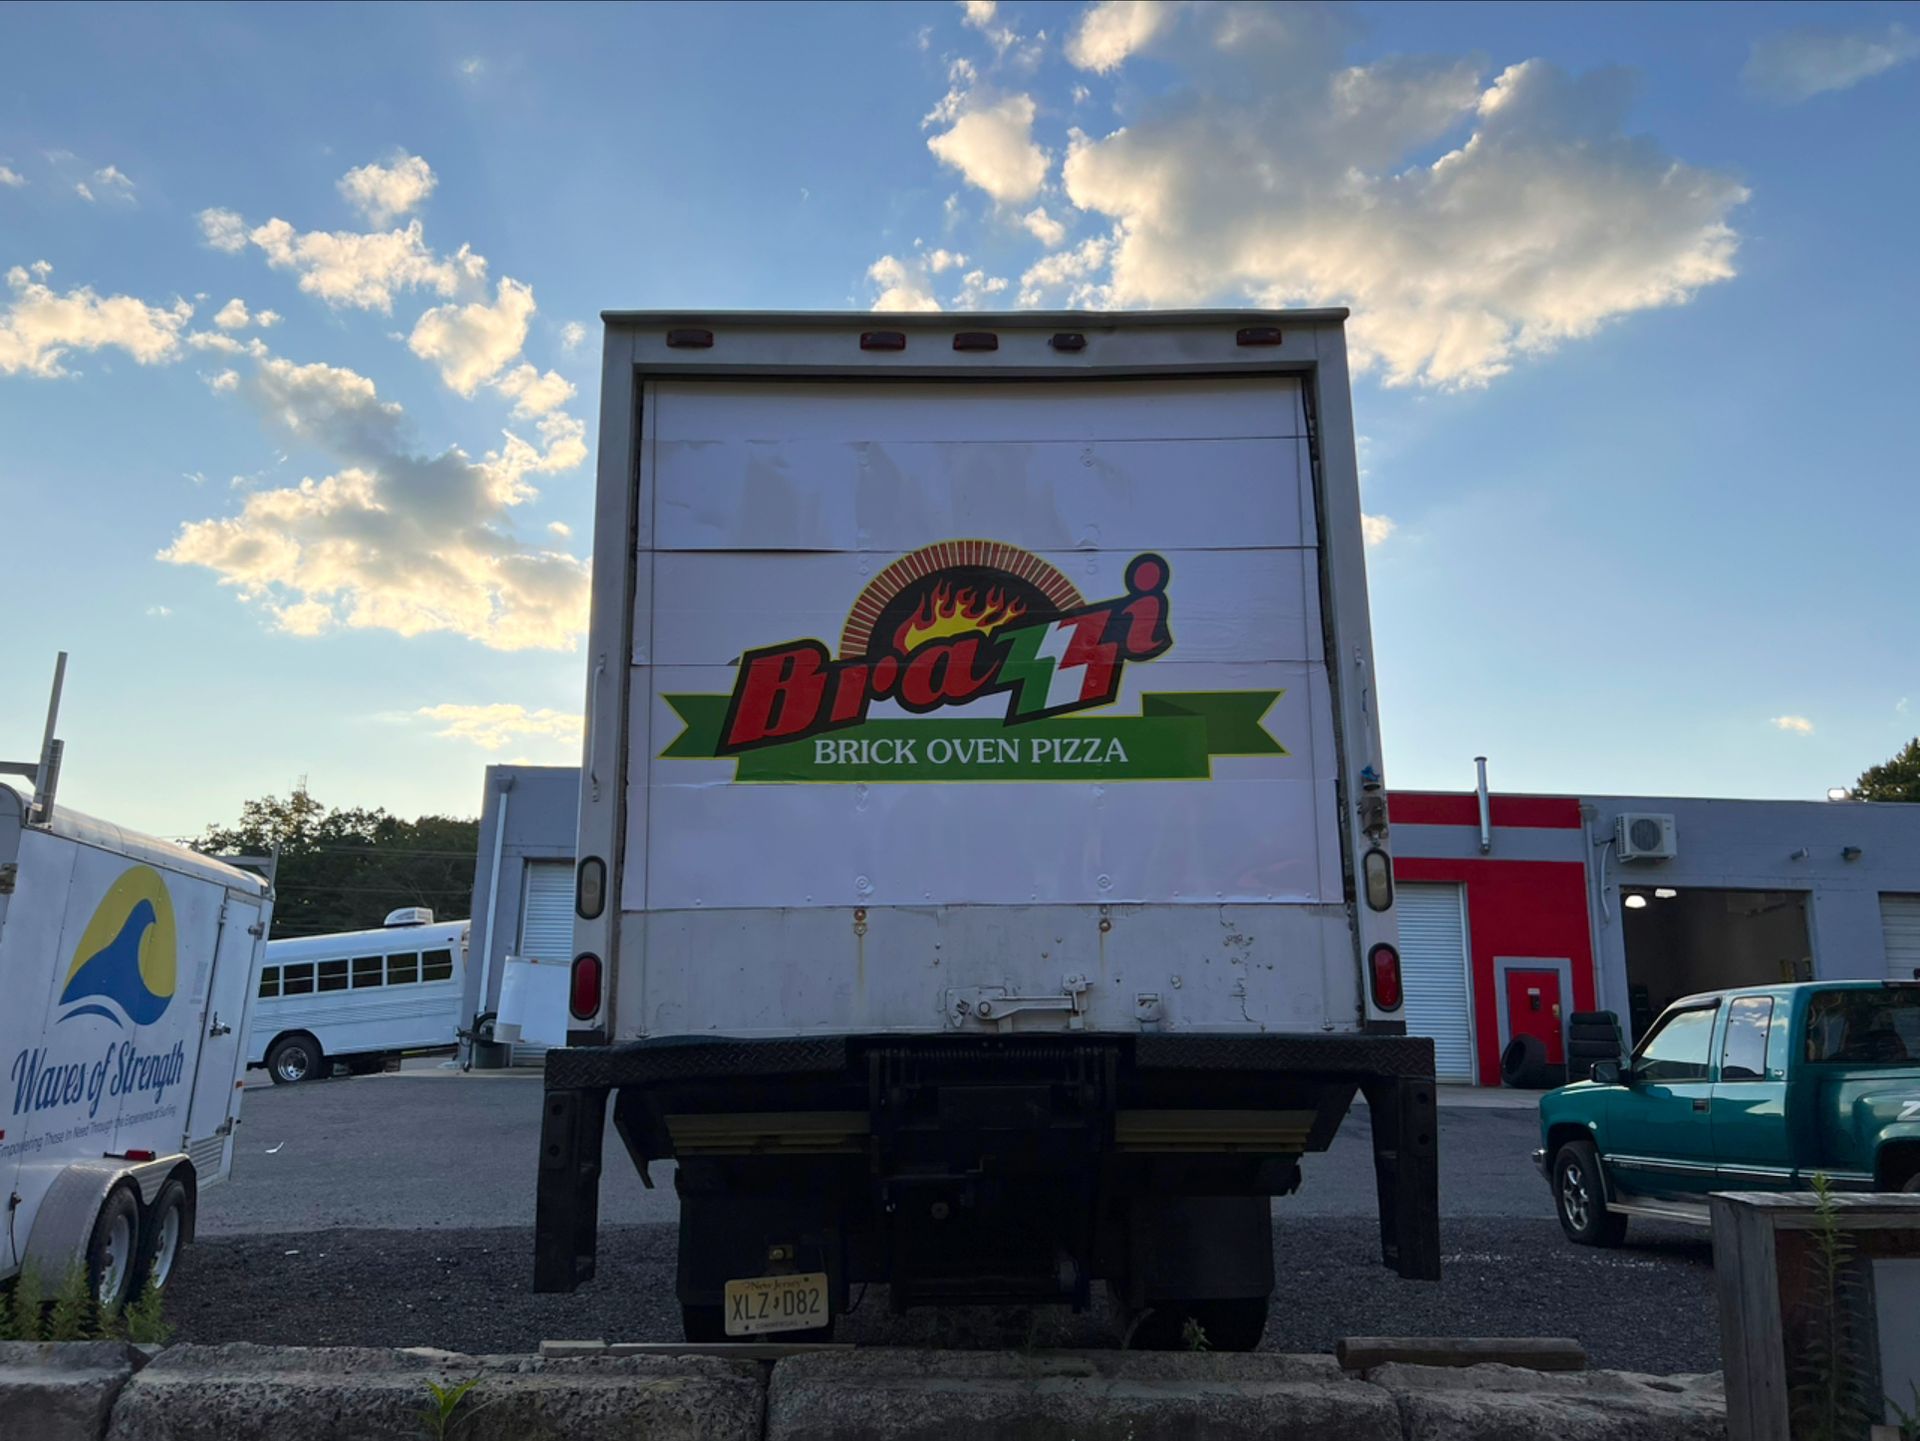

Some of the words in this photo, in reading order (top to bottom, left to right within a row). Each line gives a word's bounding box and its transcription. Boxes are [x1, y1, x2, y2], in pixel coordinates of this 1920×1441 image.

[724, 560, 1166, 747] Brazzi
[813, 739, 917, 765] BRICK
[927, 738, 1025, 764] OVEN
[1031, 737, 1129, 763] PIZZA
[11, 1047, 86, 1116] Waves
[88, 1041, 116, 1119] of
[110, 1039, 184, 1105] Strength
[45, 1132, 65, 1146] Those
[74, 1125, 89, 1138] Need
[89, 1120, 113, 1137] Through
[751, 1281, 772, 1291] New
[774, 1279, 801, 1291] Jersey
